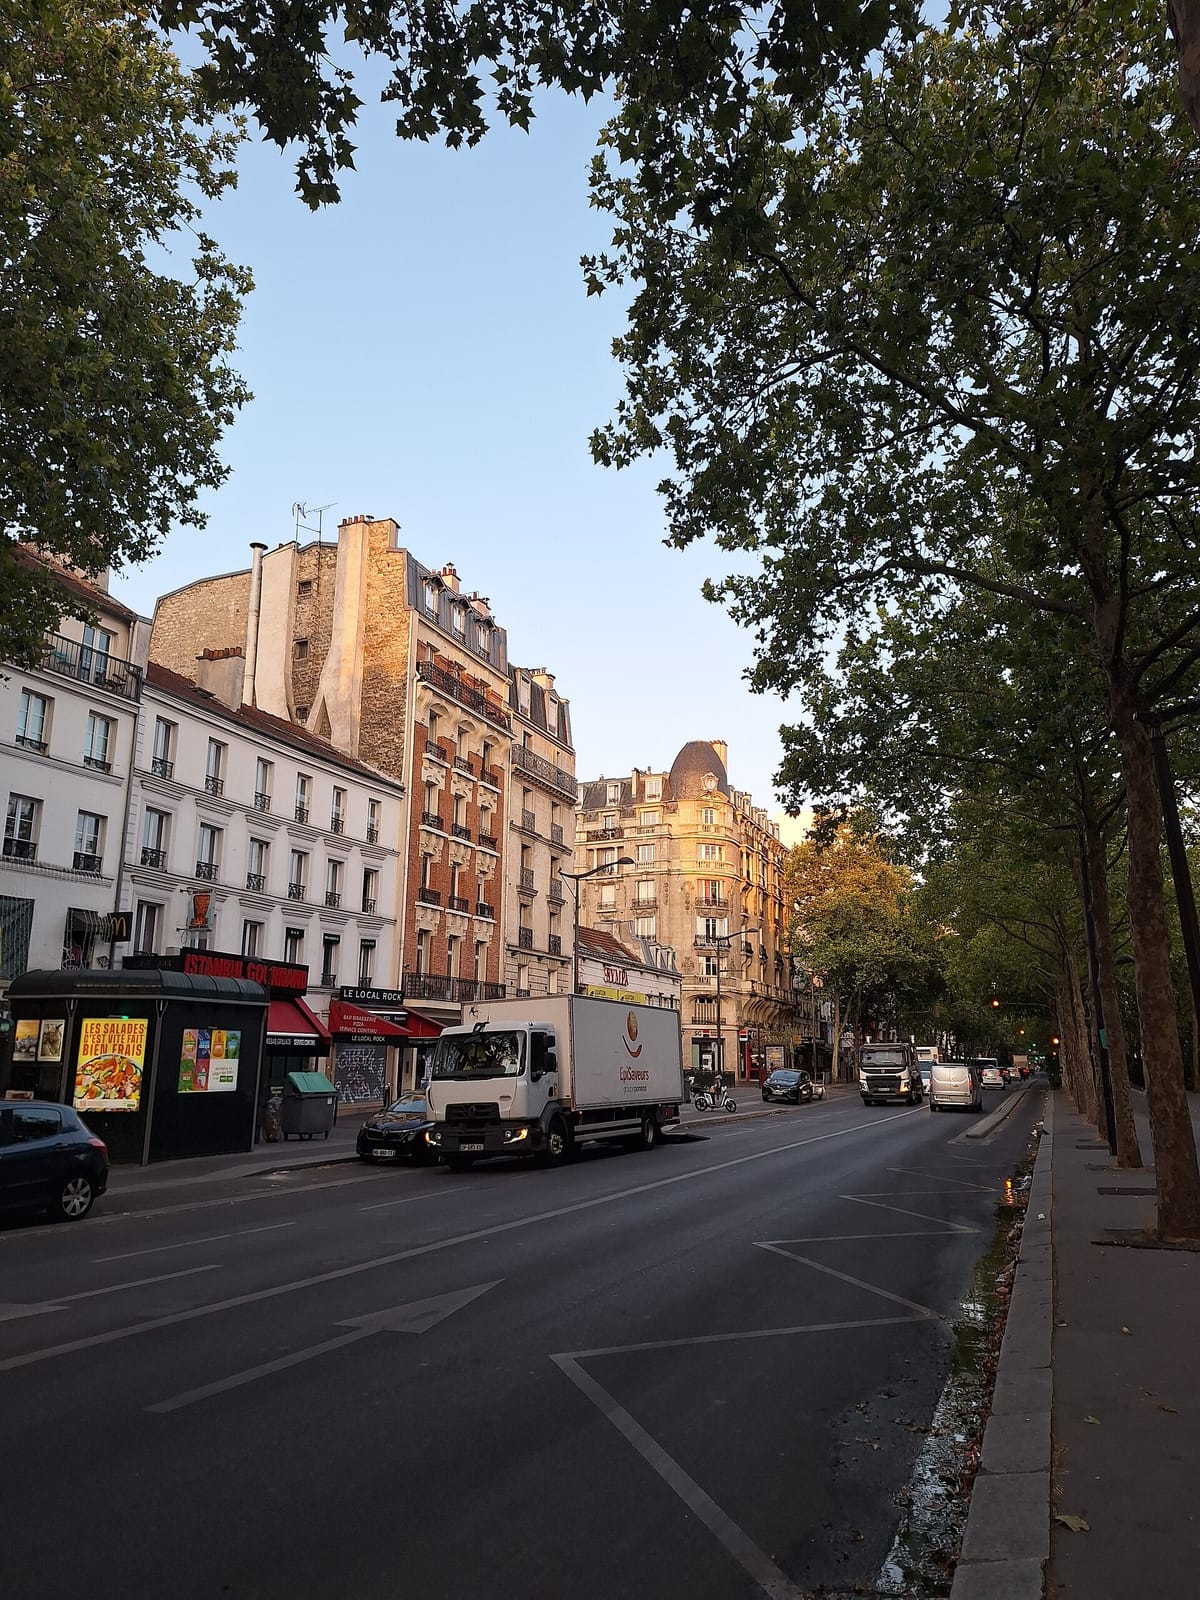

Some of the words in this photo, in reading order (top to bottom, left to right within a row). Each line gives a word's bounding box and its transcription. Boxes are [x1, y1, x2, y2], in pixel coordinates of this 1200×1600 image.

[343, 989, 353, 998] LE
[355, 990, 381, 1000] LOCAL
[382, 992, 402, 1001] ROCK
[84, 1023, 101, 1034] LES
[103, 1023, 145, 1034] SALADES
[83, 1034, 106, 1043] C'EST
[108, 1034, 125, 1043] VITE
[126, 1034, 144, 1044] FAIT
[82, 1044, 108, 1056] BIEN
[112, 1044, 142, 1056] FRAIS
[620, 1066, 650, 1083] EpiSaveurs
